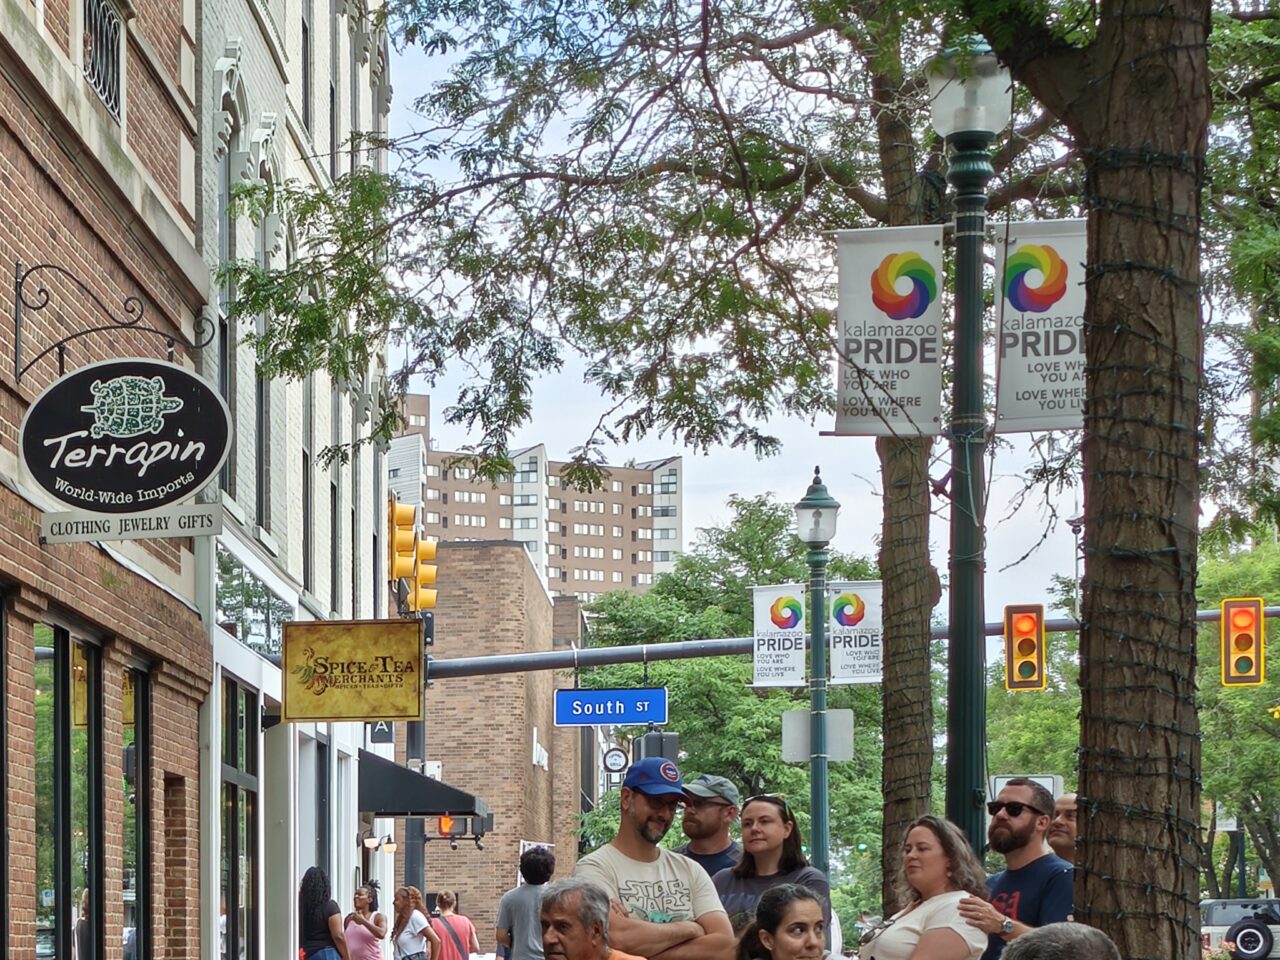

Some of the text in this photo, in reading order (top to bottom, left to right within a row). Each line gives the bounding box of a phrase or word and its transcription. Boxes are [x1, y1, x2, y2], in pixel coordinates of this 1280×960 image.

[843, 320, 937, 337] kalamazoo
[1002, 313, 1085, 331] kalamazo
[844, 337, 938, 364] PRIDE
[844, 370, 910, 379] LOVE WHO
[1028, 361, 1087, 373] LOVE WH
[1040, 372, 1067, 383] YOU
[843, 381, 897, 390] YOU ARE
[842, 397, 921, 406] LOVE WHERE
[1016, 388, 1087, 401] LOVE WHER
[842, 407, 898, 417] YOU LIVE
[1039, 400, 1066, 410] YOU
[43, 430, 206, 478] Terrapin
[54, 471, 196, 505] World-Wide Imports
[50, 513, 214, 536] CLOTHING JEWELRY GIFTS
[757, 637, 803, 651] PRIDE
[833, 634, 880, 649] PRIDE
[313, 656, 367, 675] SPICE
[375, 656, 415, 673] TEA
[323, 674, 404, 684] MERCHANTS
[572, 700, 650, 715] South ST
[619, 879, 690, 898] STAR
[620, 895, 690, 913] WARS
